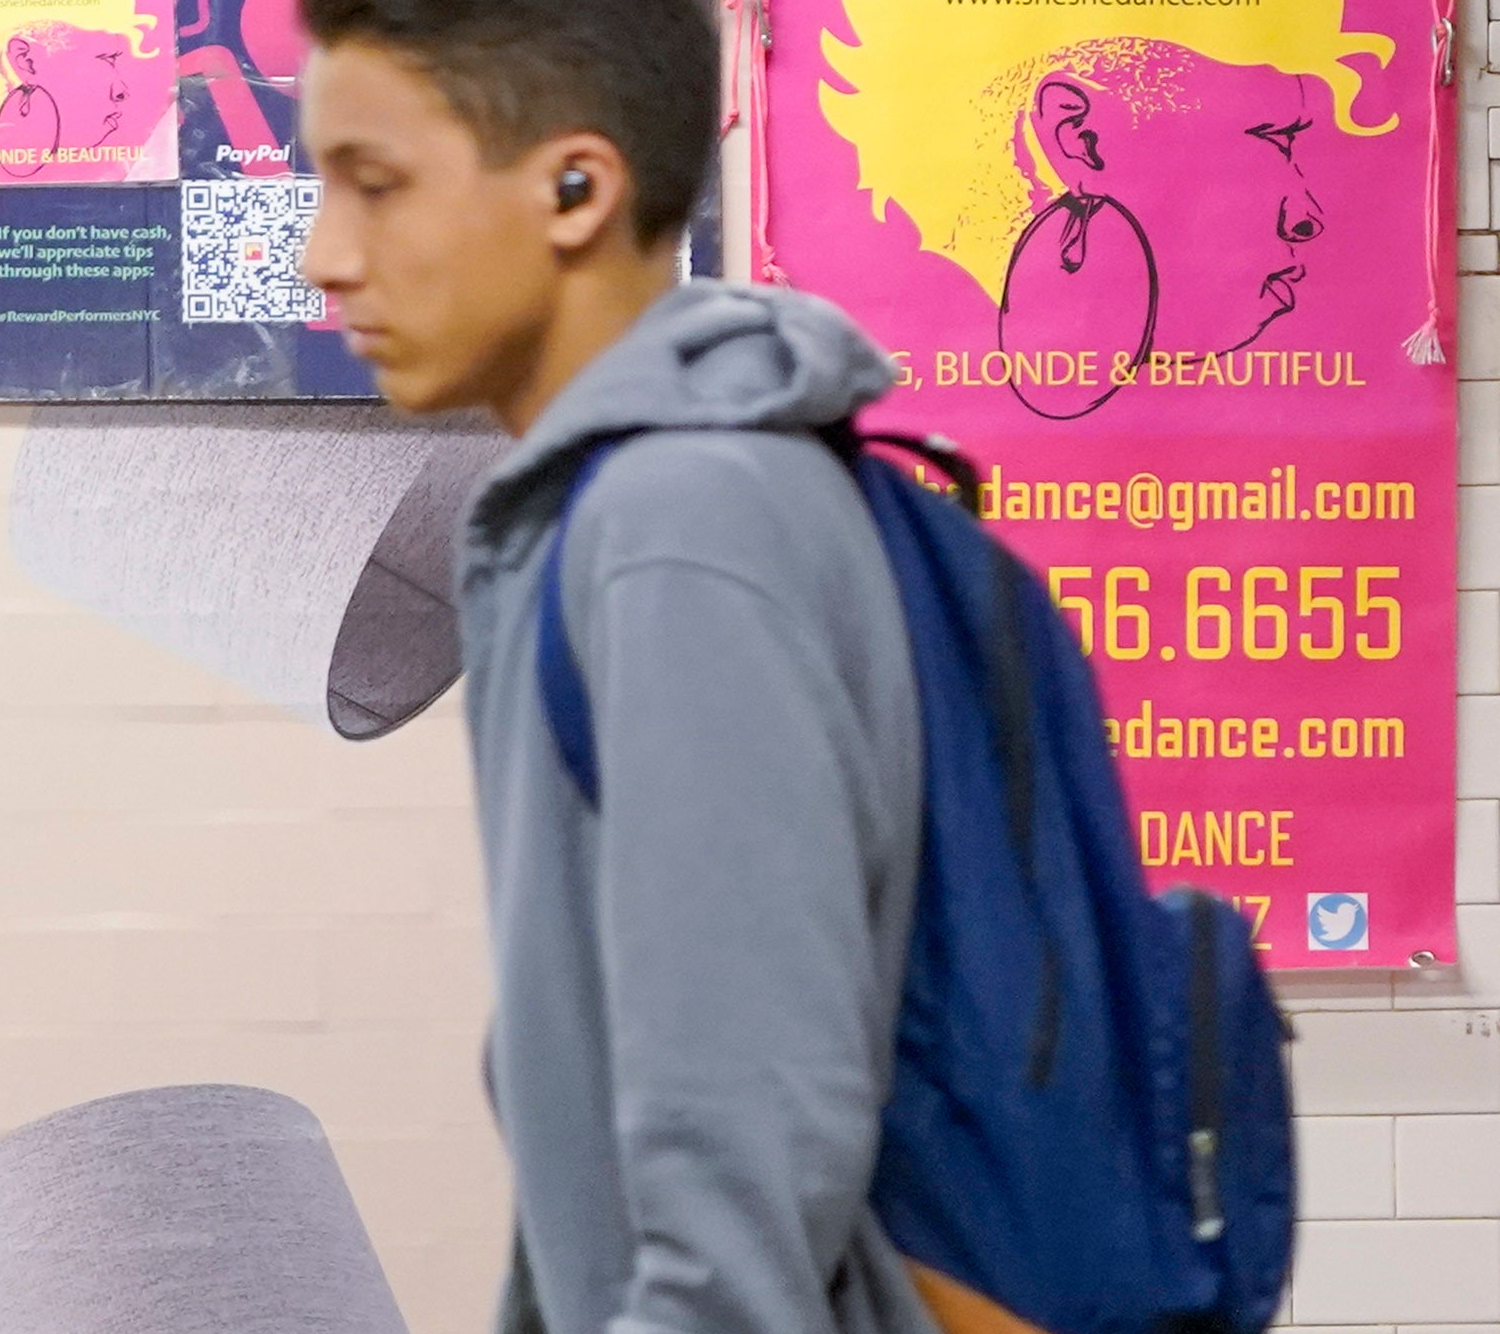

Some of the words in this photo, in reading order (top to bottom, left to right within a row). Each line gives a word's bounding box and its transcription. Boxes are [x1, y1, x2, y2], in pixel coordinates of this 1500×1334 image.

[41, 146, 54, 164] &
[216, 144, 291, 165] PayPal
[12, 228, 43, 243] you
[45, 224, 87, 240] don't
[90, 224, 130, 240] have
[132, 224, 172, 242] cash,
[37, 245, 121, 262] appreciate
[123, 244, 153, 260] tips
[66, 264, 110, 278] these
[113, 266, 155, 281] apps:
[936, 350, 1099, 387] BLONDE
[1109, 350, 1139, 387] &
[1150, 350, 1366, 387] BEAUTIFUL
[1046, 565, 1402, 662] 56.6655
[1139, 810, 1295, 867] DANCE
